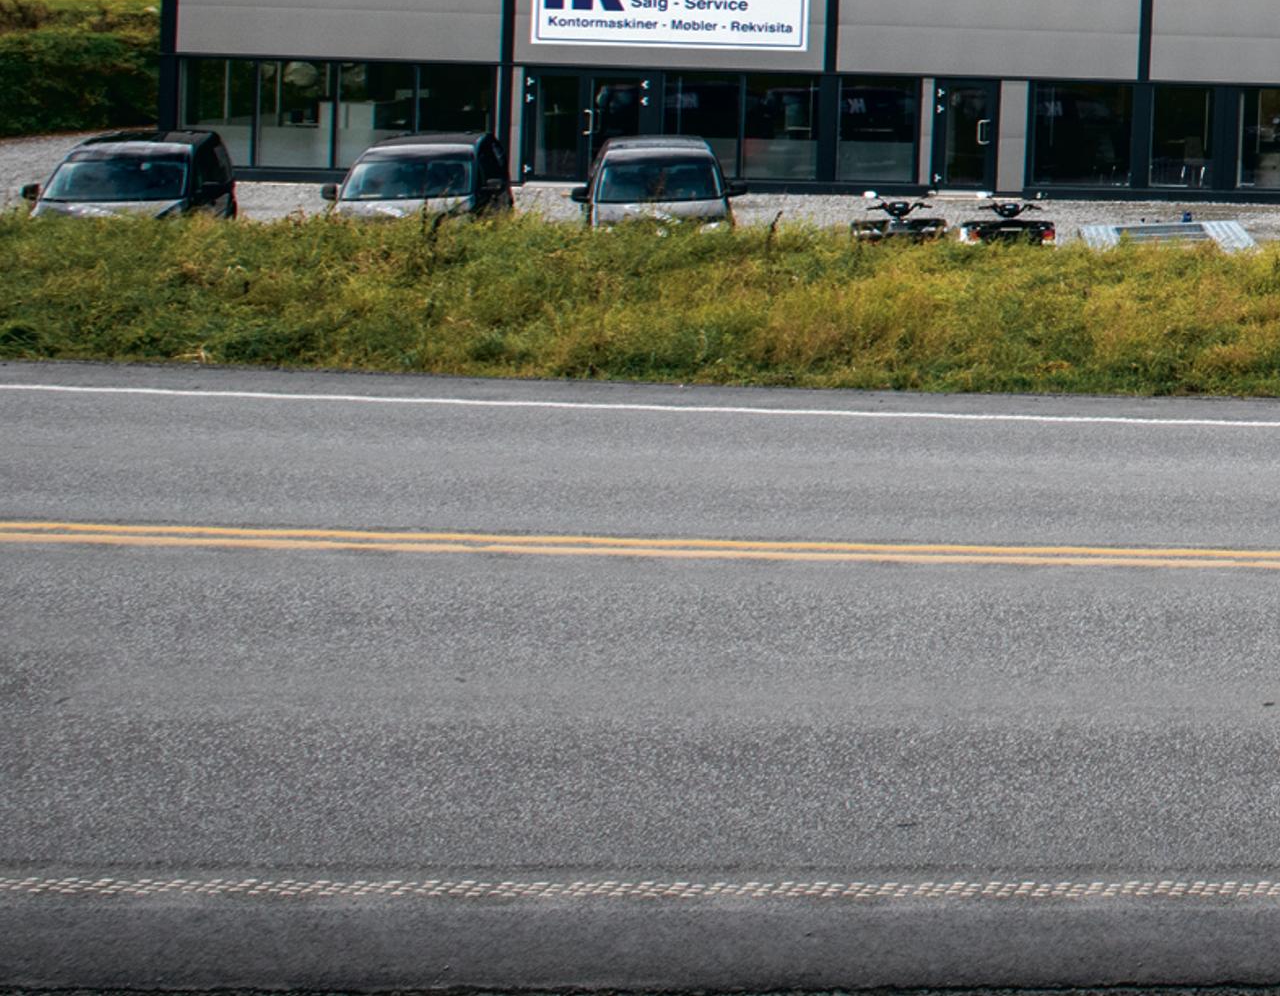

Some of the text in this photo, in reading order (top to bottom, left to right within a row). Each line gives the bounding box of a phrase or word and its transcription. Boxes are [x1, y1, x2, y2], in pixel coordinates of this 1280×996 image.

[548, 15, 658, 30] Kontormaskiner
[671, 19, 718, 32] Møbler
[730, 21, 793, 34] Rekvisita
